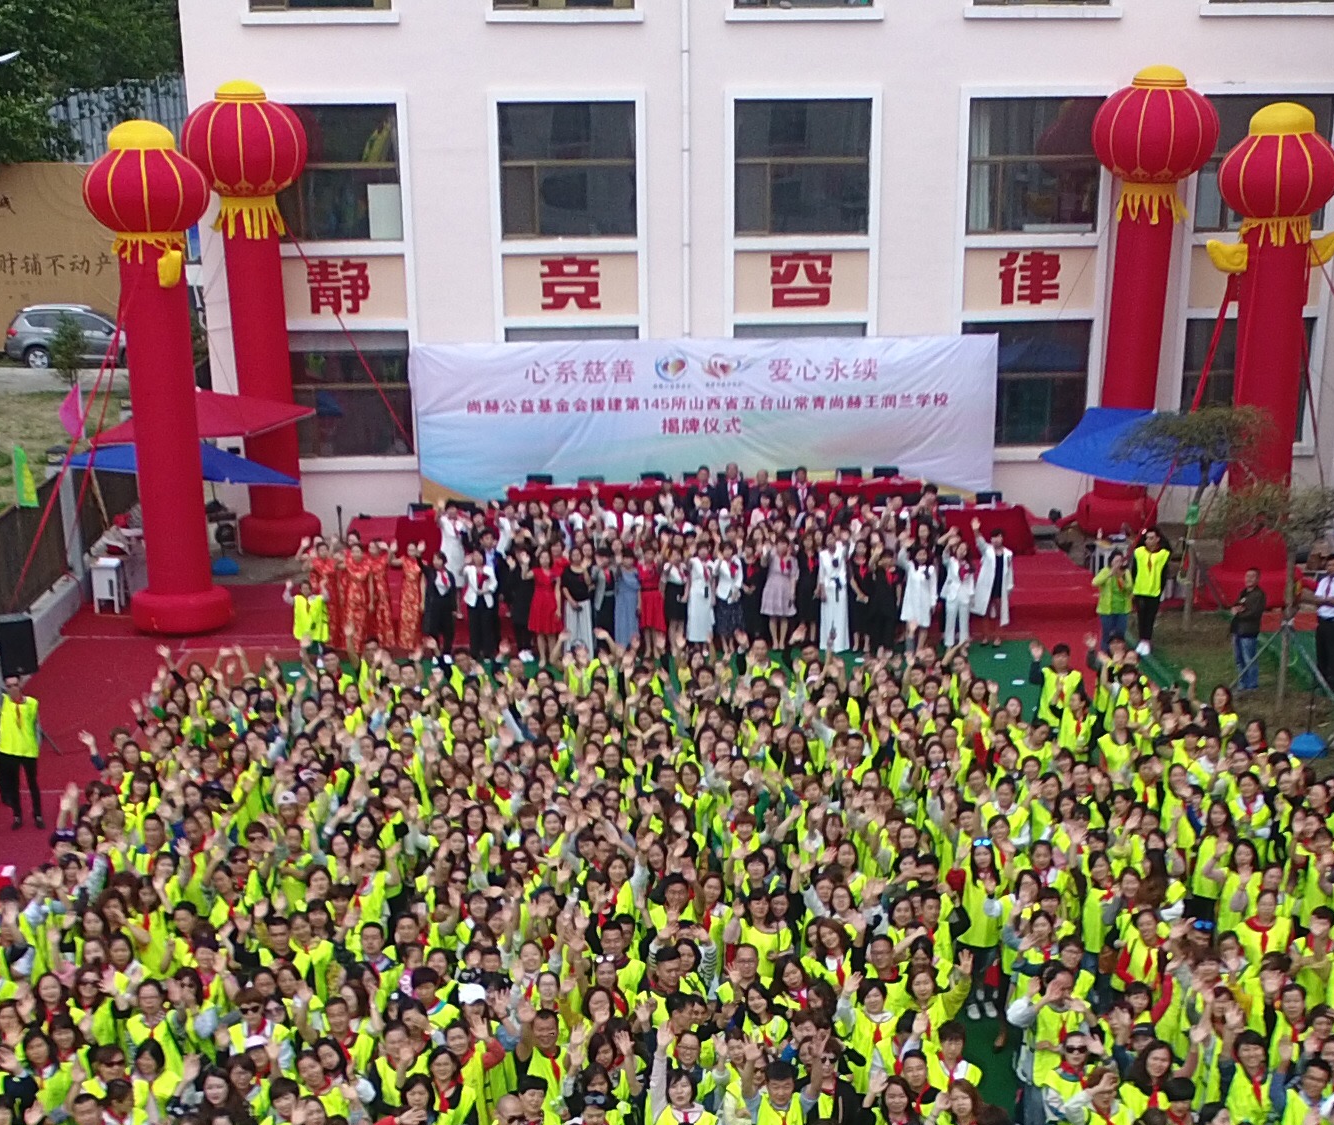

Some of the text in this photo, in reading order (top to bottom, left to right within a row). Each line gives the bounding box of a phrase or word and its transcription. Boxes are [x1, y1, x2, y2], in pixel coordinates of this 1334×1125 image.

[307, 258, 371, 315] 静
[998, 251, 1061, 306] 律
[525, 357, 879, 385] 心系慈善 爱心永续
[661, 416, 742, 435] 揭牌仪式
